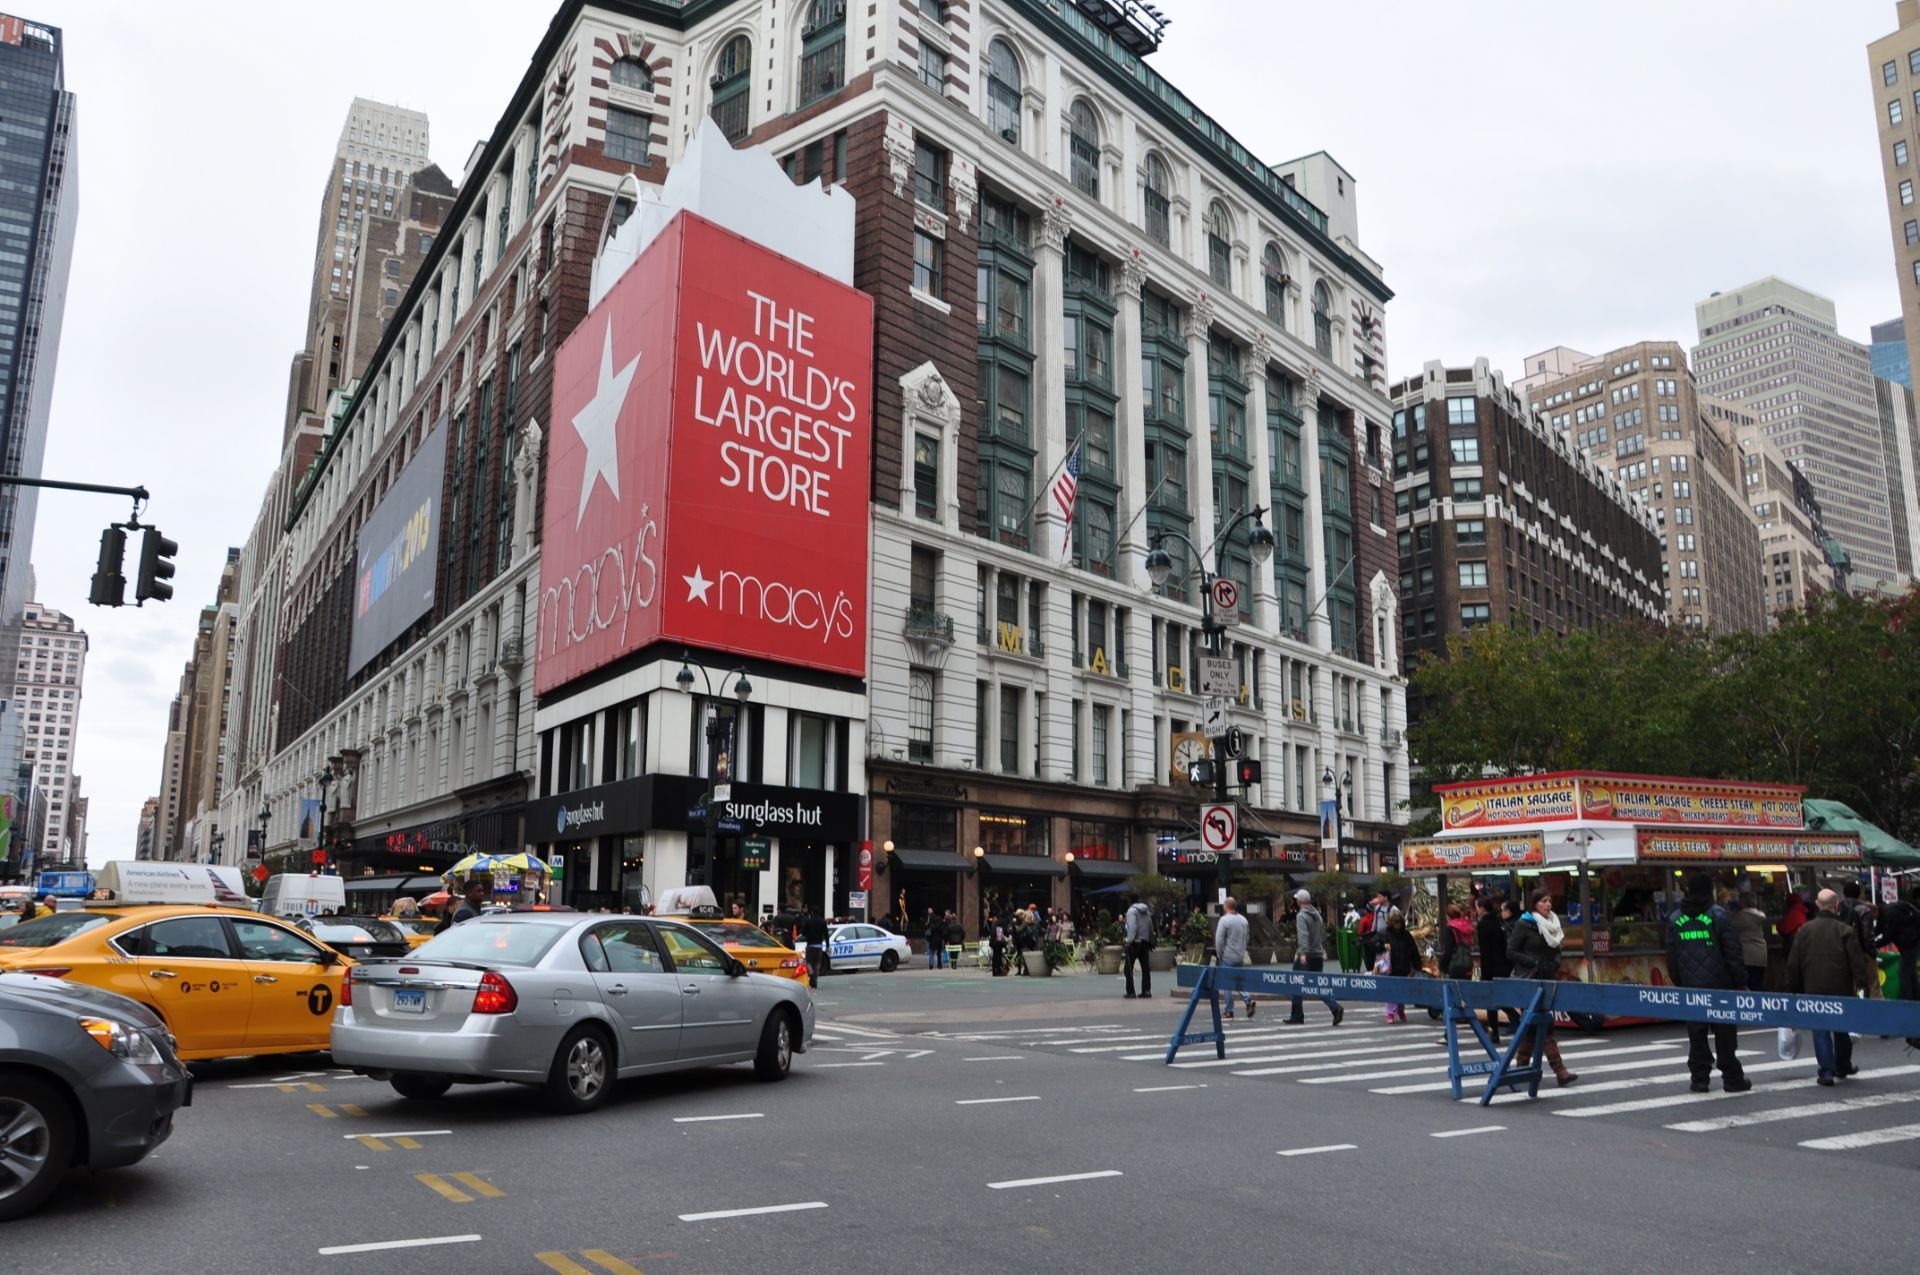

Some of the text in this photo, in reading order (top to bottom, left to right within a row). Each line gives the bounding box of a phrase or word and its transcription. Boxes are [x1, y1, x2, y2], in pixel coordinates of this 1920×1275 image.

[747, 289, 814, 358] THE
[696, 321, 856, 423] WORLD'S
[694, 375, 852, 470] LARGEST
[720, 441, 830, 517] STORE
[1206, 660, 1232, 669] BUSES
[1209, 670, 1230, 680] ONLY
[1205, 699, 1222, 709] KEEP
[1205, 725, 1224, 736] RIGHT
[1486, 796, 1524, 809] ITALIAN
[1527, 791, 1573, 805] SAUSAGE
[1615, 792, 1651, 805] ITALIAN
[1653, 795, 1692, 808] SAUSAGE
[1699, 797, 1728, 809] CHEESE
[1730, 798, 1754, 810] STEAK
[1761, 801, 1776, 812] HOT
[1778, 801, 1799, 813] DOGS
[565, 800, 604, 830] sunglass hut
[725, 799, 822, 828] sunglass hut
[1487, 810, 1502, 821] HOT
[1503, 808, 1521, 819] DOGS
[1526, 805, 1574, 817] HAMBURGERS
[1617, 808, 1663, 819] HAMBURGERS
[1680, 810, 1705, 821] CHICKEN
[1707, 811, 1729, 822] BREAST
[1743, 813, 1760, 823] FRIES
[1651, 839, 1681, 852] CHEESE
[1682, 841, 1711, 853] STEAKS
[1724, 843, 1754, 854] ITALIAN
[1756, 842, 1788, 854] SAUSAGE
[1187, 851, 1219, 865] macy
[1678, 929, 1710, 941] TOURS
[833, 945, 854, 954] NYPD
[1263, 973, 1287, 984] POLICE
[1289, 974, 1305, 985] LINE
[1317, 975, 1329, 986] DO
[1331, 976, 1348, 988] NOT
[1350, 978, 1377, 989] CROSS
[1301, 986, 1318, 995] POLICE
[1639, 990, 1680, 1005] POLICE
[1686, 993, 1713, 1007] LINE
[1736, 995, 1755, 1009] DO
[1761, 998, 1789, 1012] NOT
[1796, 999, 1844, 1015] CROSS
[1706, 1008, 1765, 1022] POLICE DEPT.
[1462, 1063, 1484, 1073] POLICE
